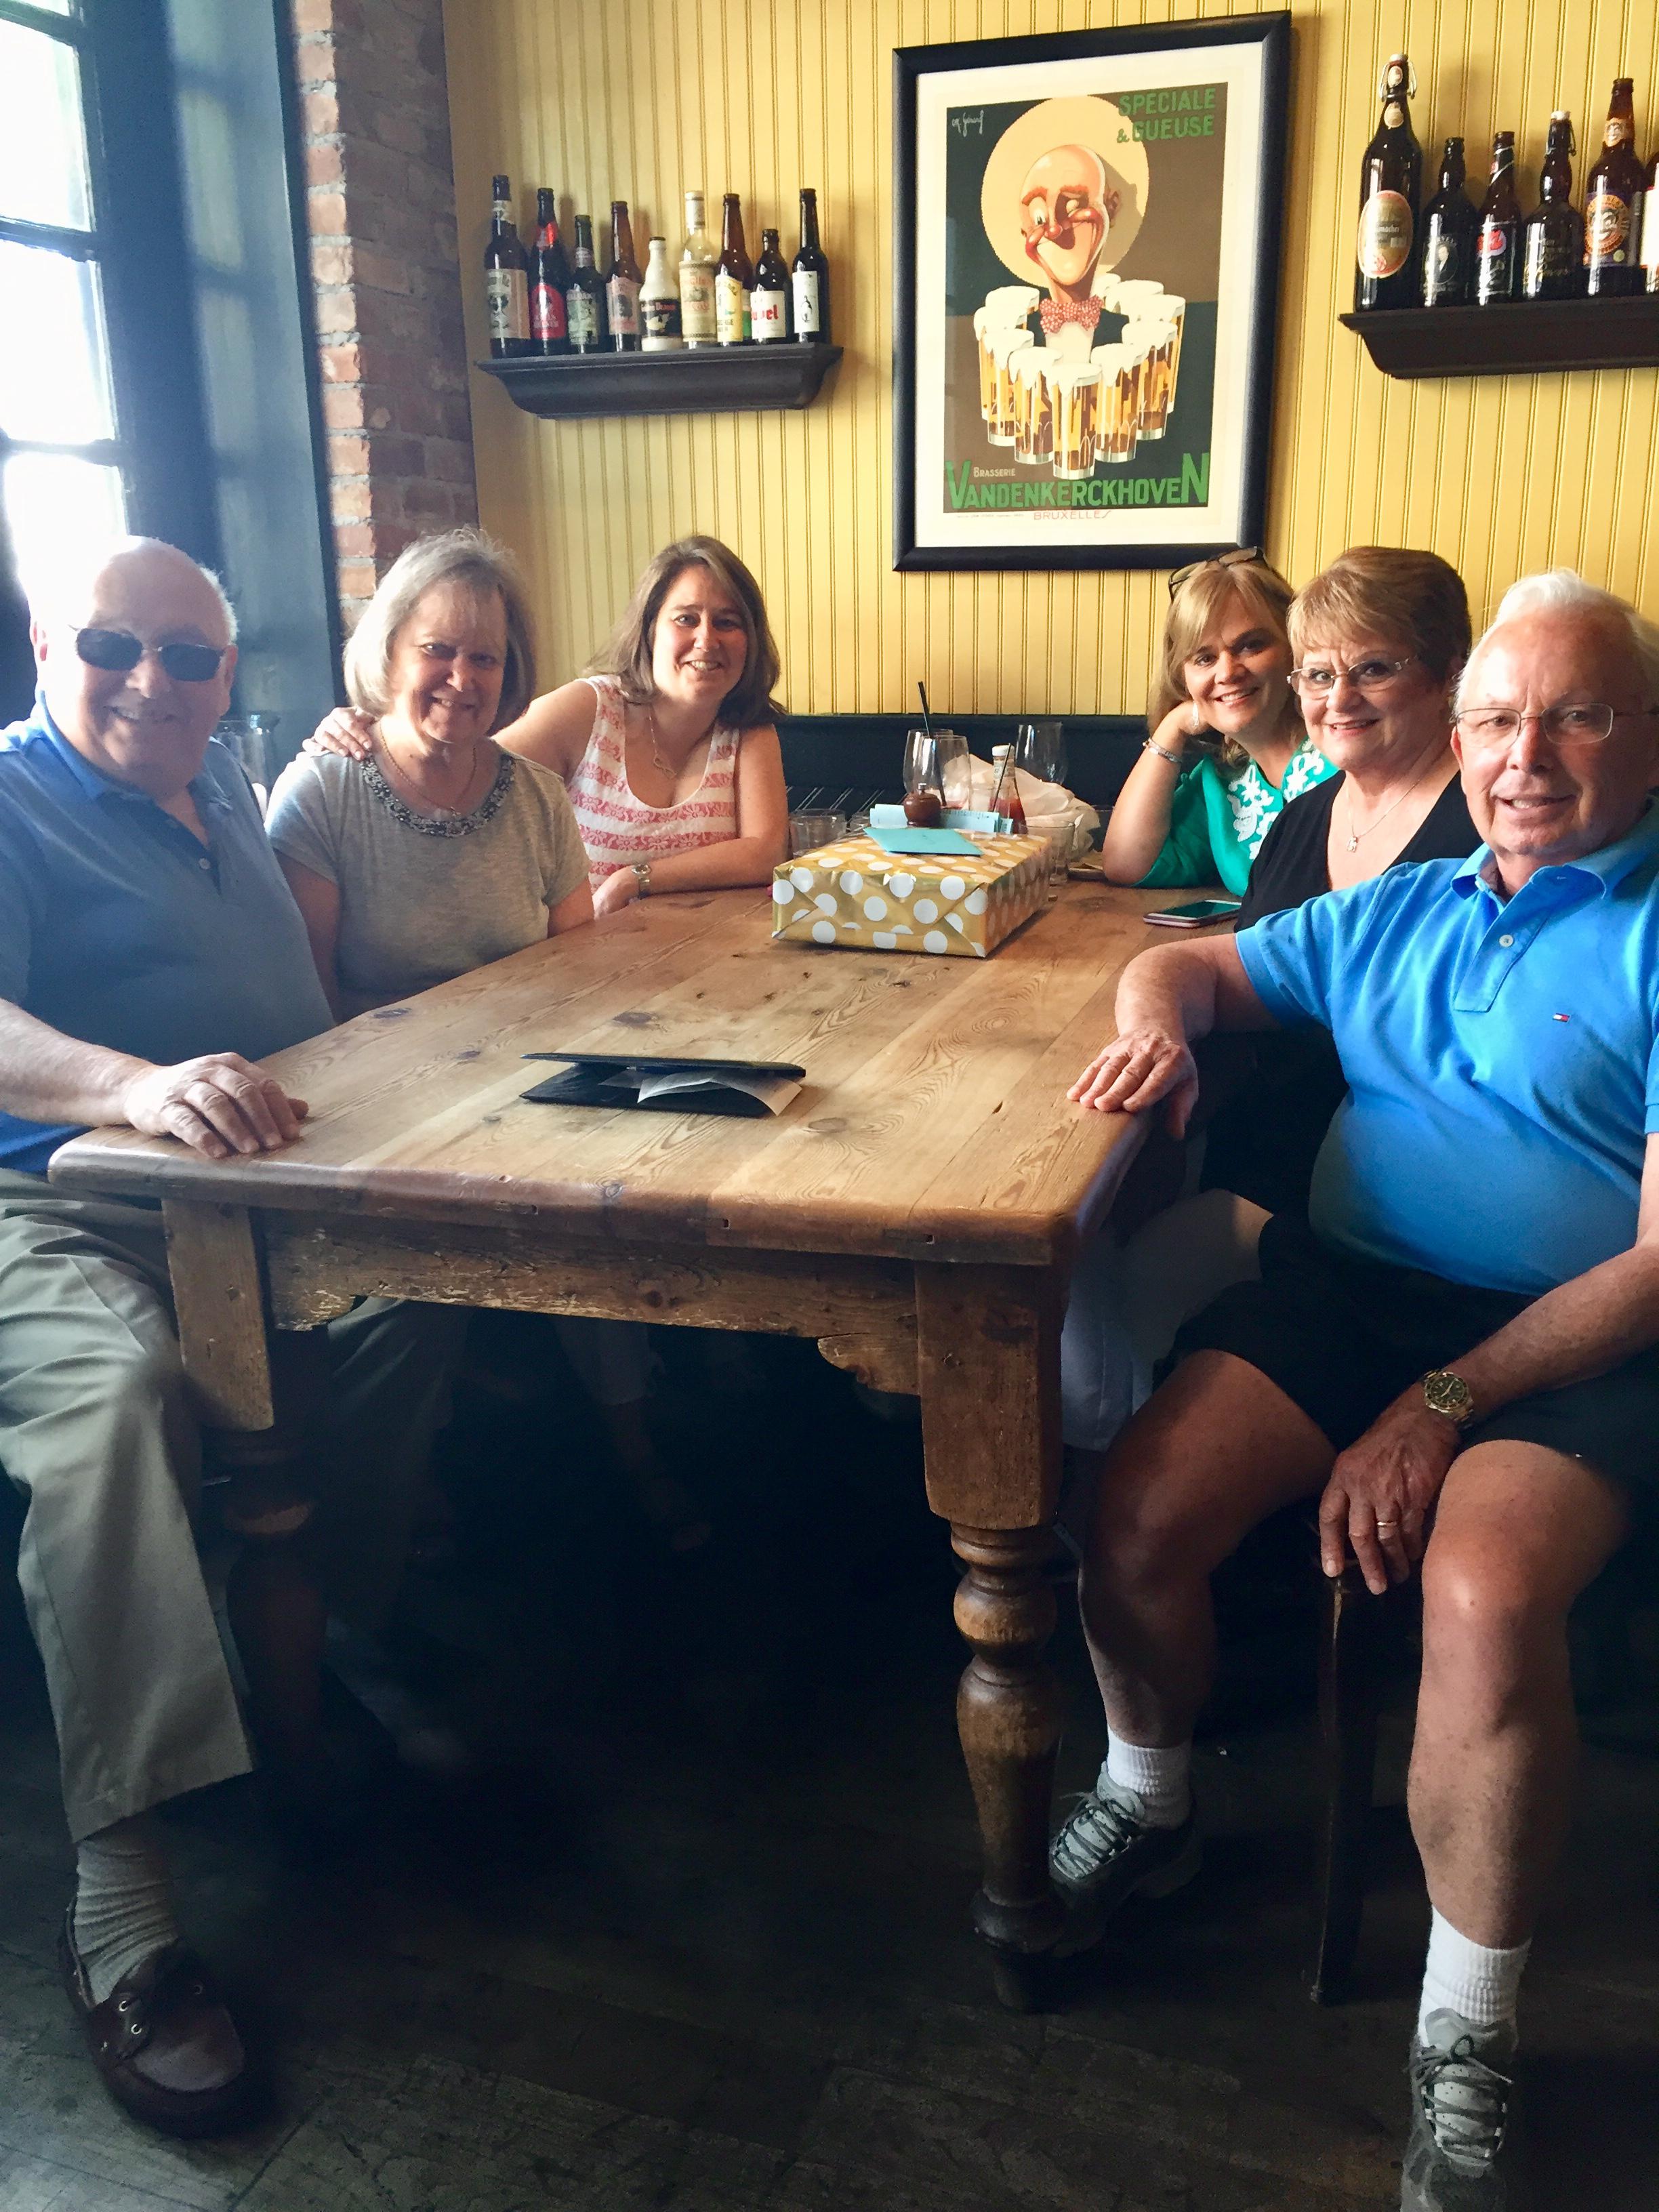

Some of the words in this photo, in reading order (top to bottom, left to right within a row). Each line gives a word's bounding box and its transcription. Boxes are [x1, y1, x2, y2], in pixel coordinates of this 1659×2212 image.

[1119, 87, 1216, 116] SPECIALE
[1117, 129, 1130, 143] &
[1132, 115, 1215, 142] GUEUSE
[945, 452, 1210, 509] VANDENKERCKHOVEN
[973, 466, 1016, 478] BRASSERIE
[1033, 510, 1111, 520] BRUXELLES
